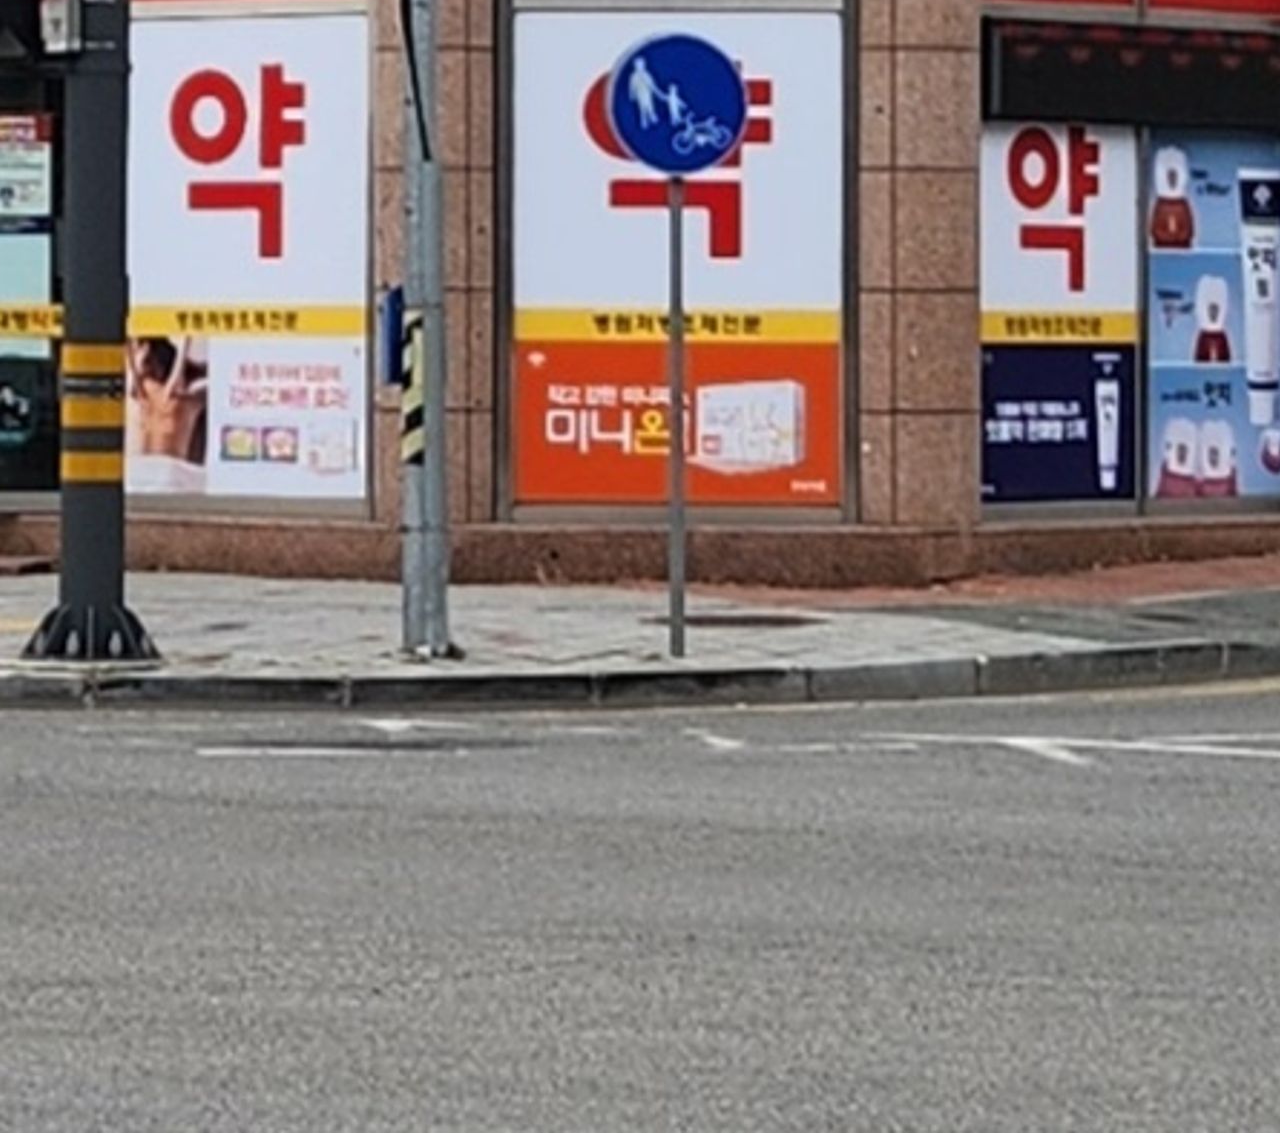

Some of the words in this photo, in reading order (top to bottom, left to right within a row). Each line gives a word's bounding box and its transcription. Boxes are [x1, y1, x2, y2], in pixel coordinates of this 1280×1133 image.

[169, 64, 306, 259] 약
[1007, 125, 1100, 292] 약
[546, 409, 671, 454] 미니온
